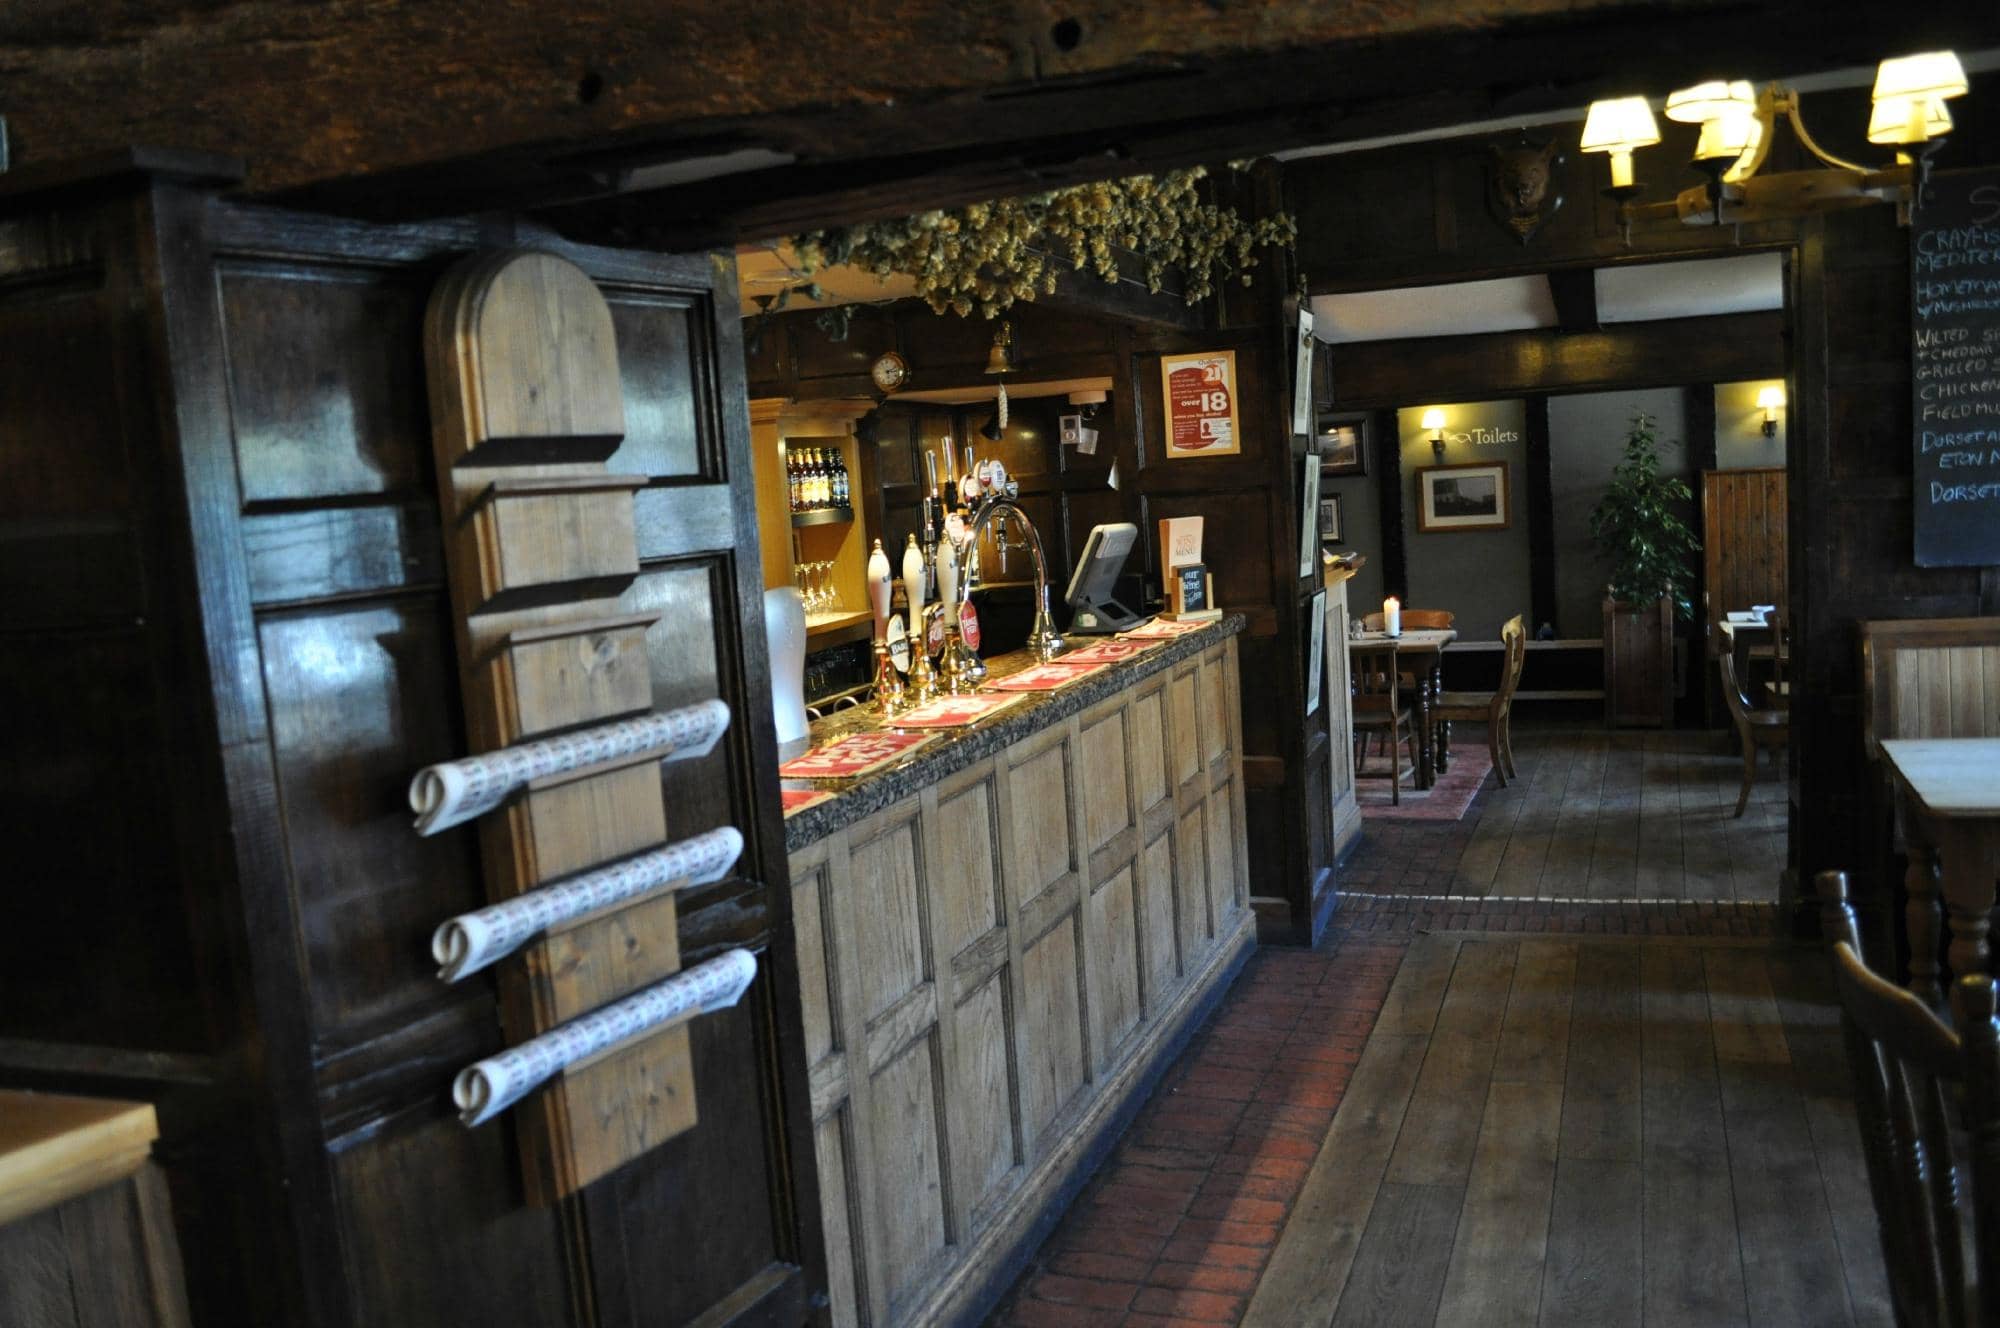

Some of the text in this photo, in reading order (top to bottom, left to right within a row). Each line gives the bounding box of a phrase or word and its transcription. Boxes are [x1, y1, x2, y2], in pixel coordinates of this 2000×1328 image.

[1916, 279, 2000, 303] HOMEMA
[1916, 328, 1968, 348] WILTED
[1916, 358, 1987, 381] GRILLED
[1181, 391, 1228, 412] over 18
[1923, 403, 1971, 422] FIELD
[1472, 427, 1518, 444] Toilets
[1922, 431, 1985, 453] DORSET
